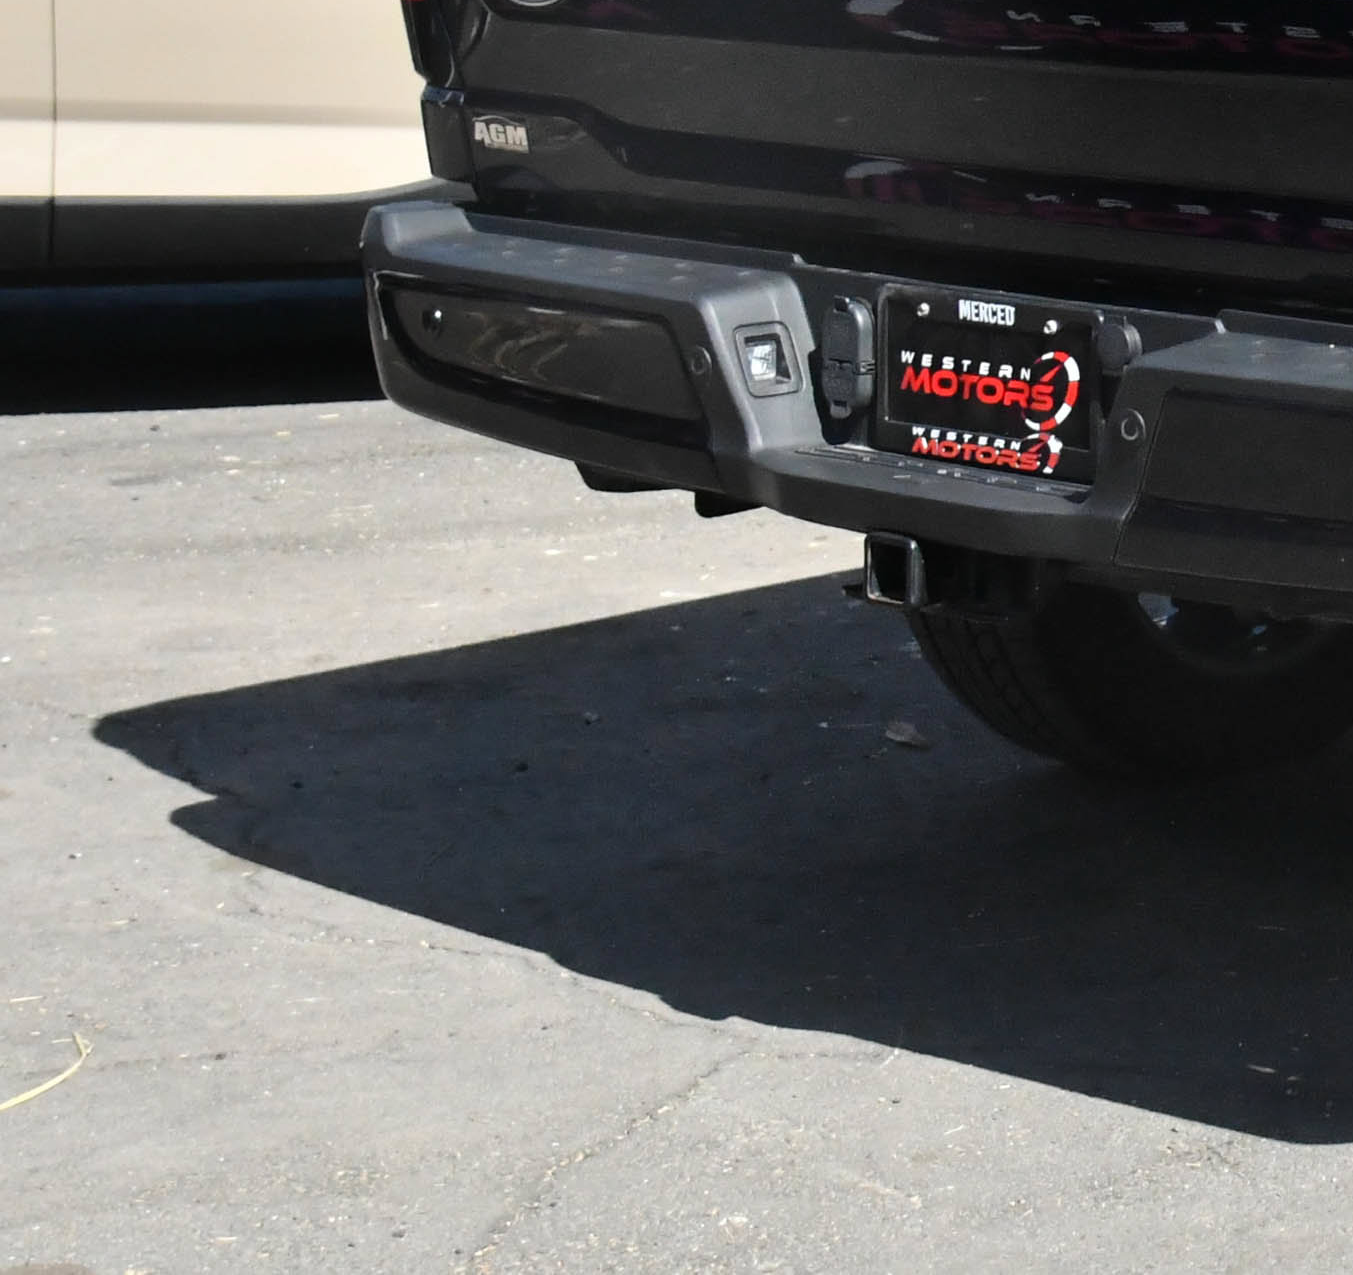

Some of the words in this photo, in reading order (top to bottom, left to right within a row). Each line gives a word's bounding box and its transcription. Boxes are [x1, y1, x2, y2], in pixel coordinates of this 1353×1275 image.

[474, 121, 528, 148] AGM
[958, 299, 1016, 326] MERCED
[901, 350, 1031, 381] WESTERN
[901, 366, 1055, 412] MOTORS
[912, 426, 1021, 451] WESTERN
[911, 436, 1042, 472] MOTORS
